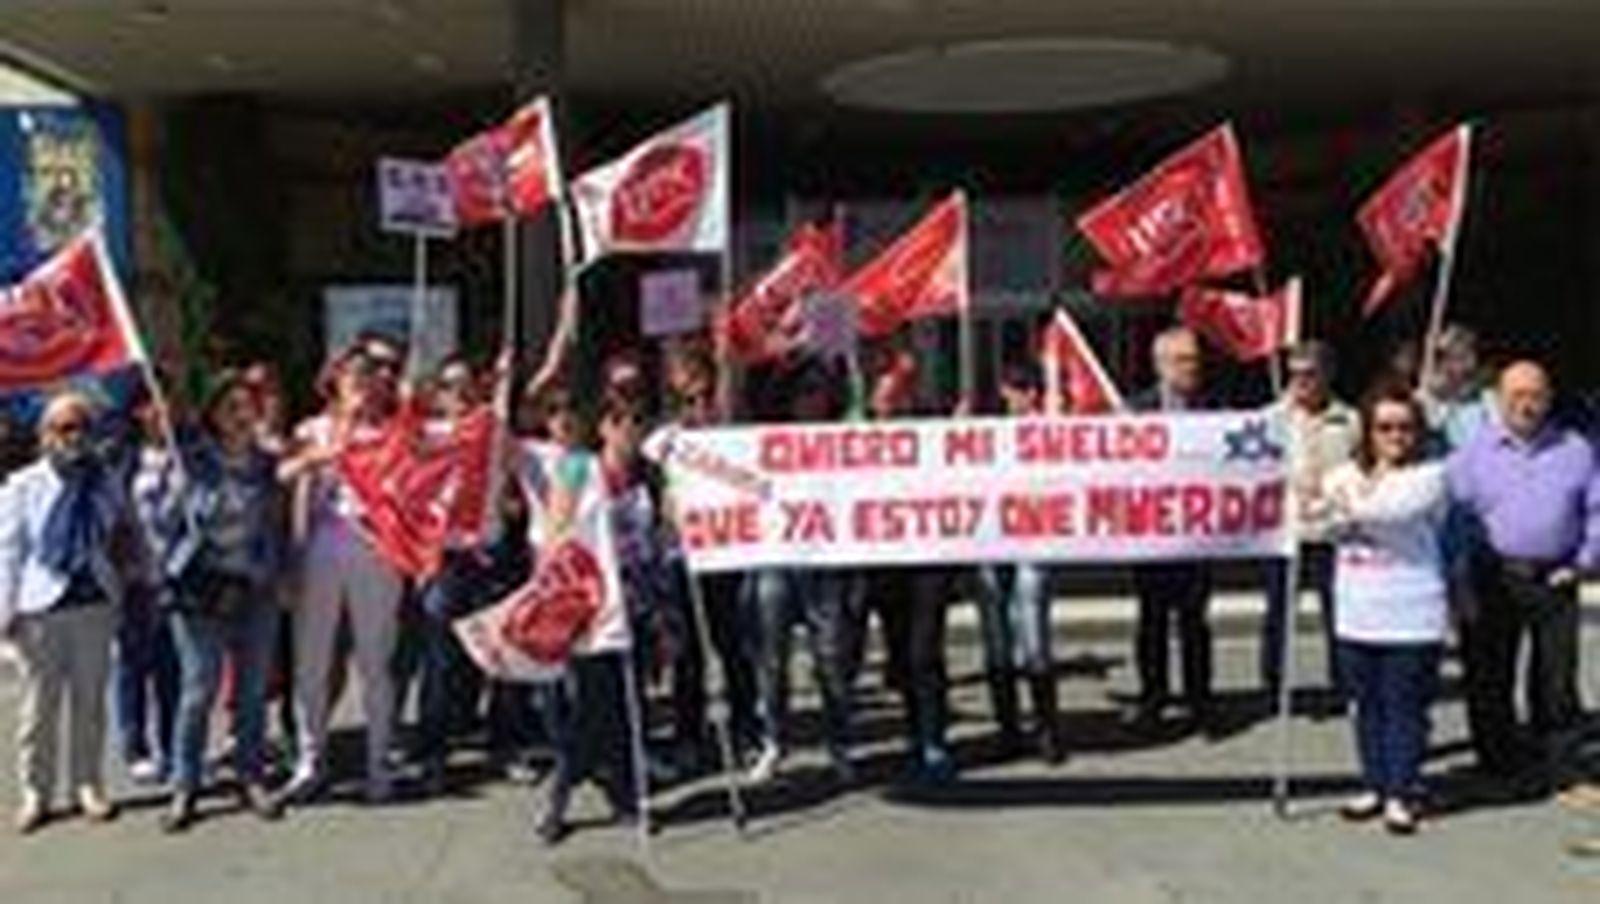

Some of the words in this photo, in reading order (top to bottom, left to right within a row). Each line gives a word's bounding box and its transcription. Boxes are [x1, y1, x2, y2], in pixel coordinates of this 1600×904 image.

[760, 430, 920, 472] QUIERO
[944, 427, 995, 466] MI
[1015, 422, 1169, 462] SUELDO
[779, 500, 836, 542] YA
[853, 493, 980, 541] ESTOY
[1001, 494, 1076, 537] QUE
[1085, 480, 1286, 537] MUERDO
